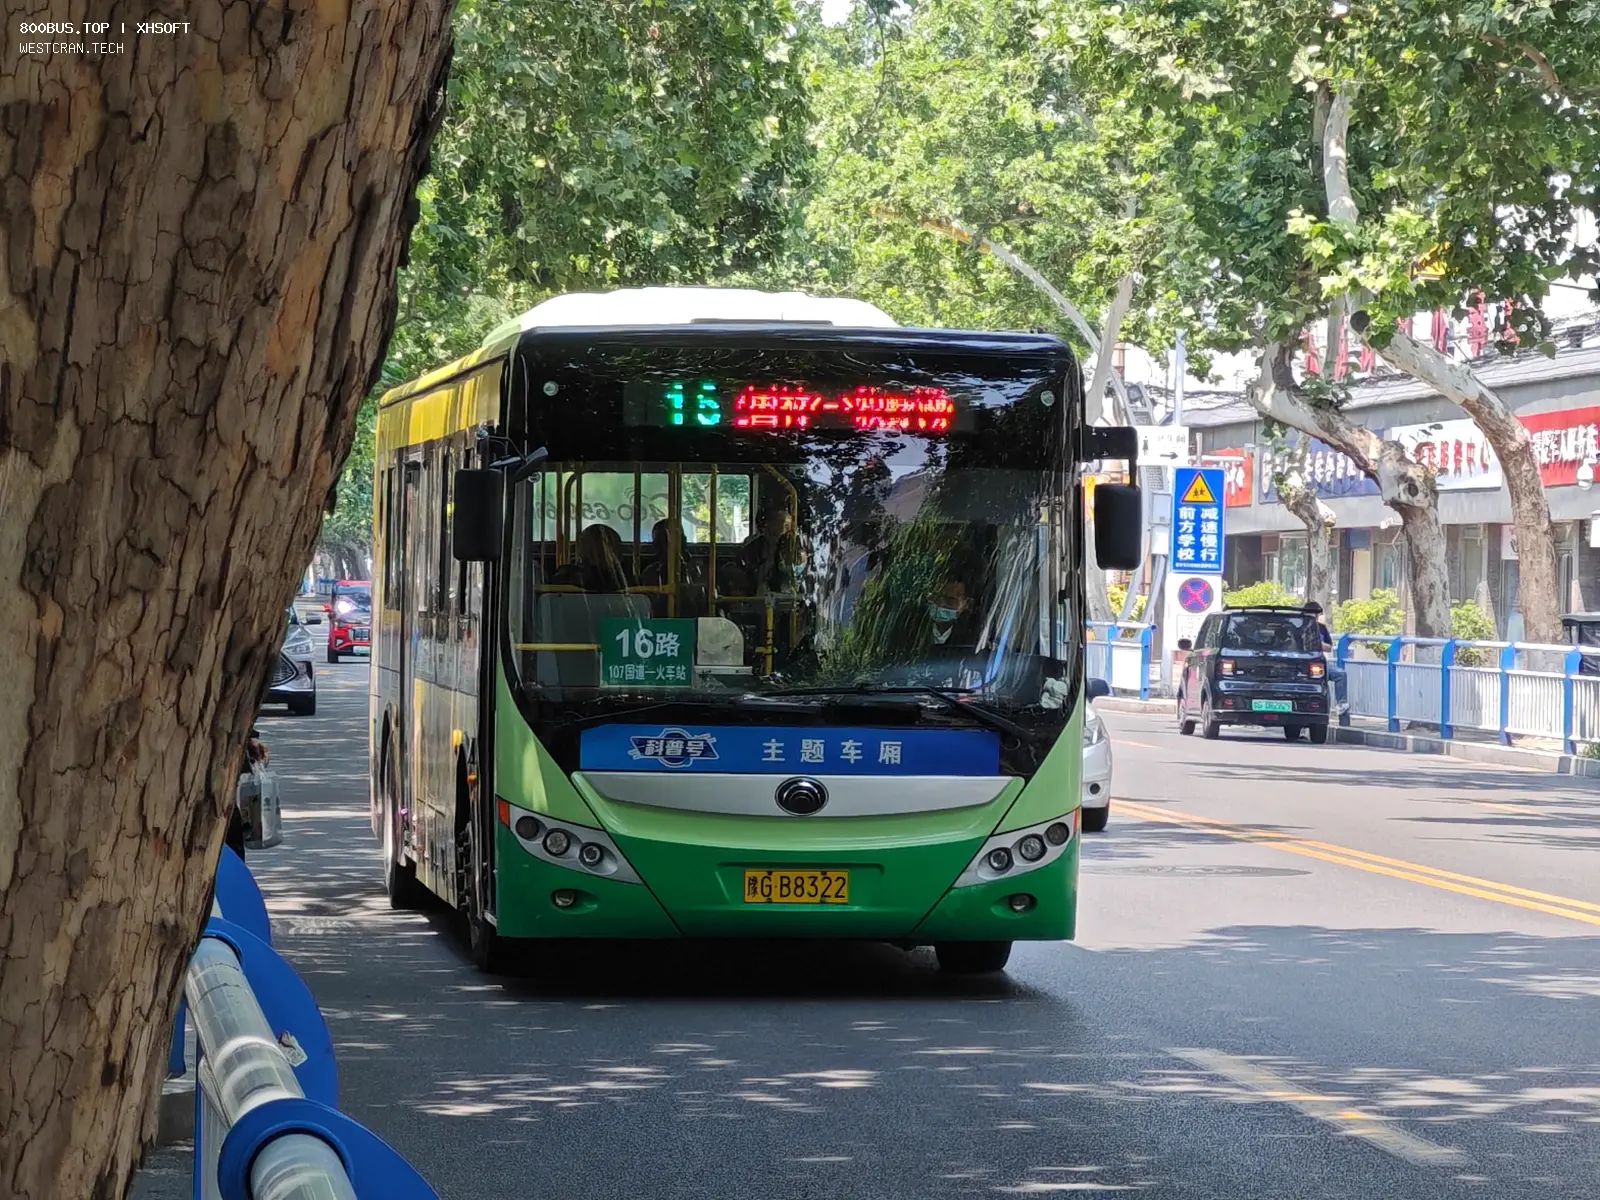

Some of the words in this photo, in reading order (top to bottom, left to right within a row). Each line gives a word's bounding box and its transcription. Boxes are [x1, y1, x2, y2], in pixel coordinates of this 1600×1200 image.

[1177, 506, 1196, 561] 前方学校
[1200, 506, 1219, 561] 减速慢行
[615, 627, 681, 659] 16路
[644, 738, 705, 757] 科普号
[761, 738, 903, 765] 主题车厢
